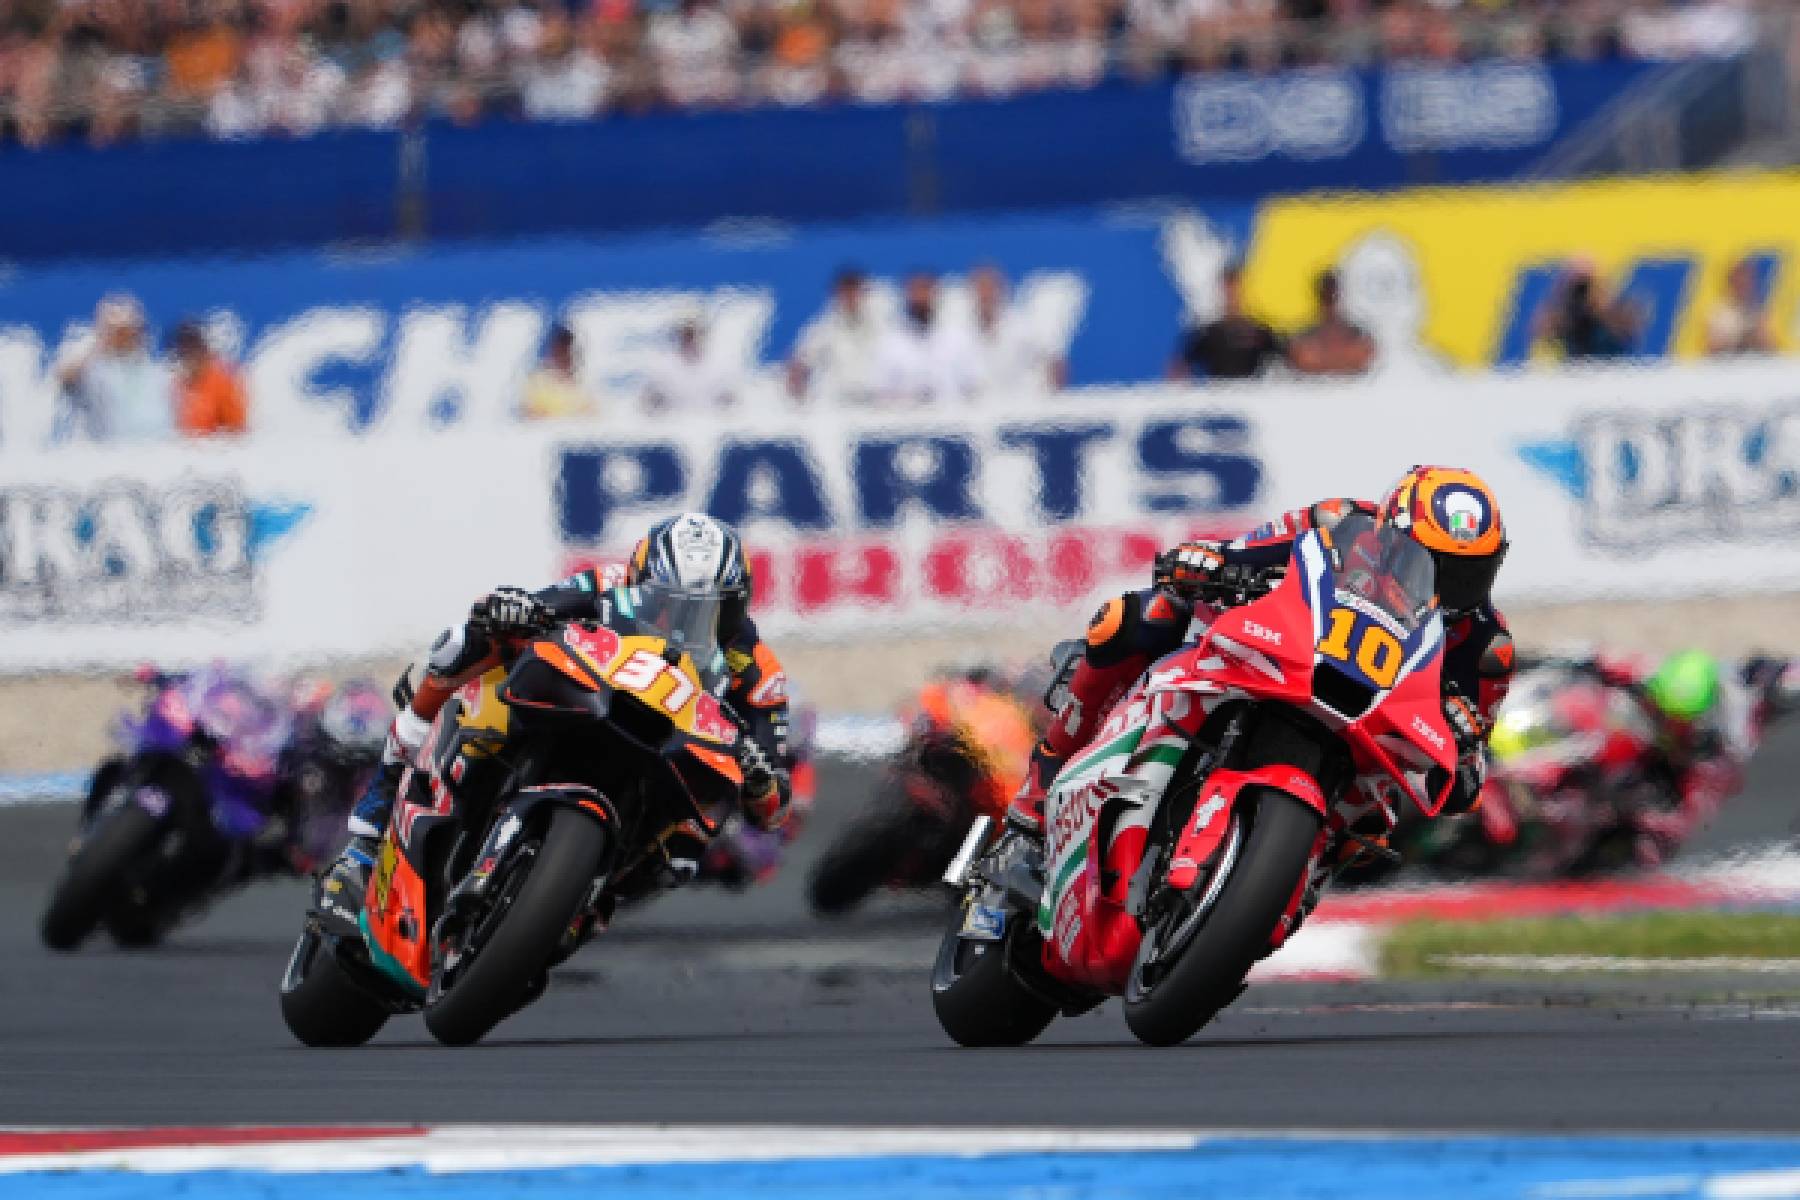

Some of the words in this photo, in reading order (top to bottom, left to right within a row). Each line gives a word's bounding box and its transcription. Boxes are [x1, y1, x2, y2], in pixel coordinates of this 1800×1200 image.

[558, 415, 1262, 542] PARTS
[611, 648, 698, 715] 37
[1316, 608, 1402, 689] 10
